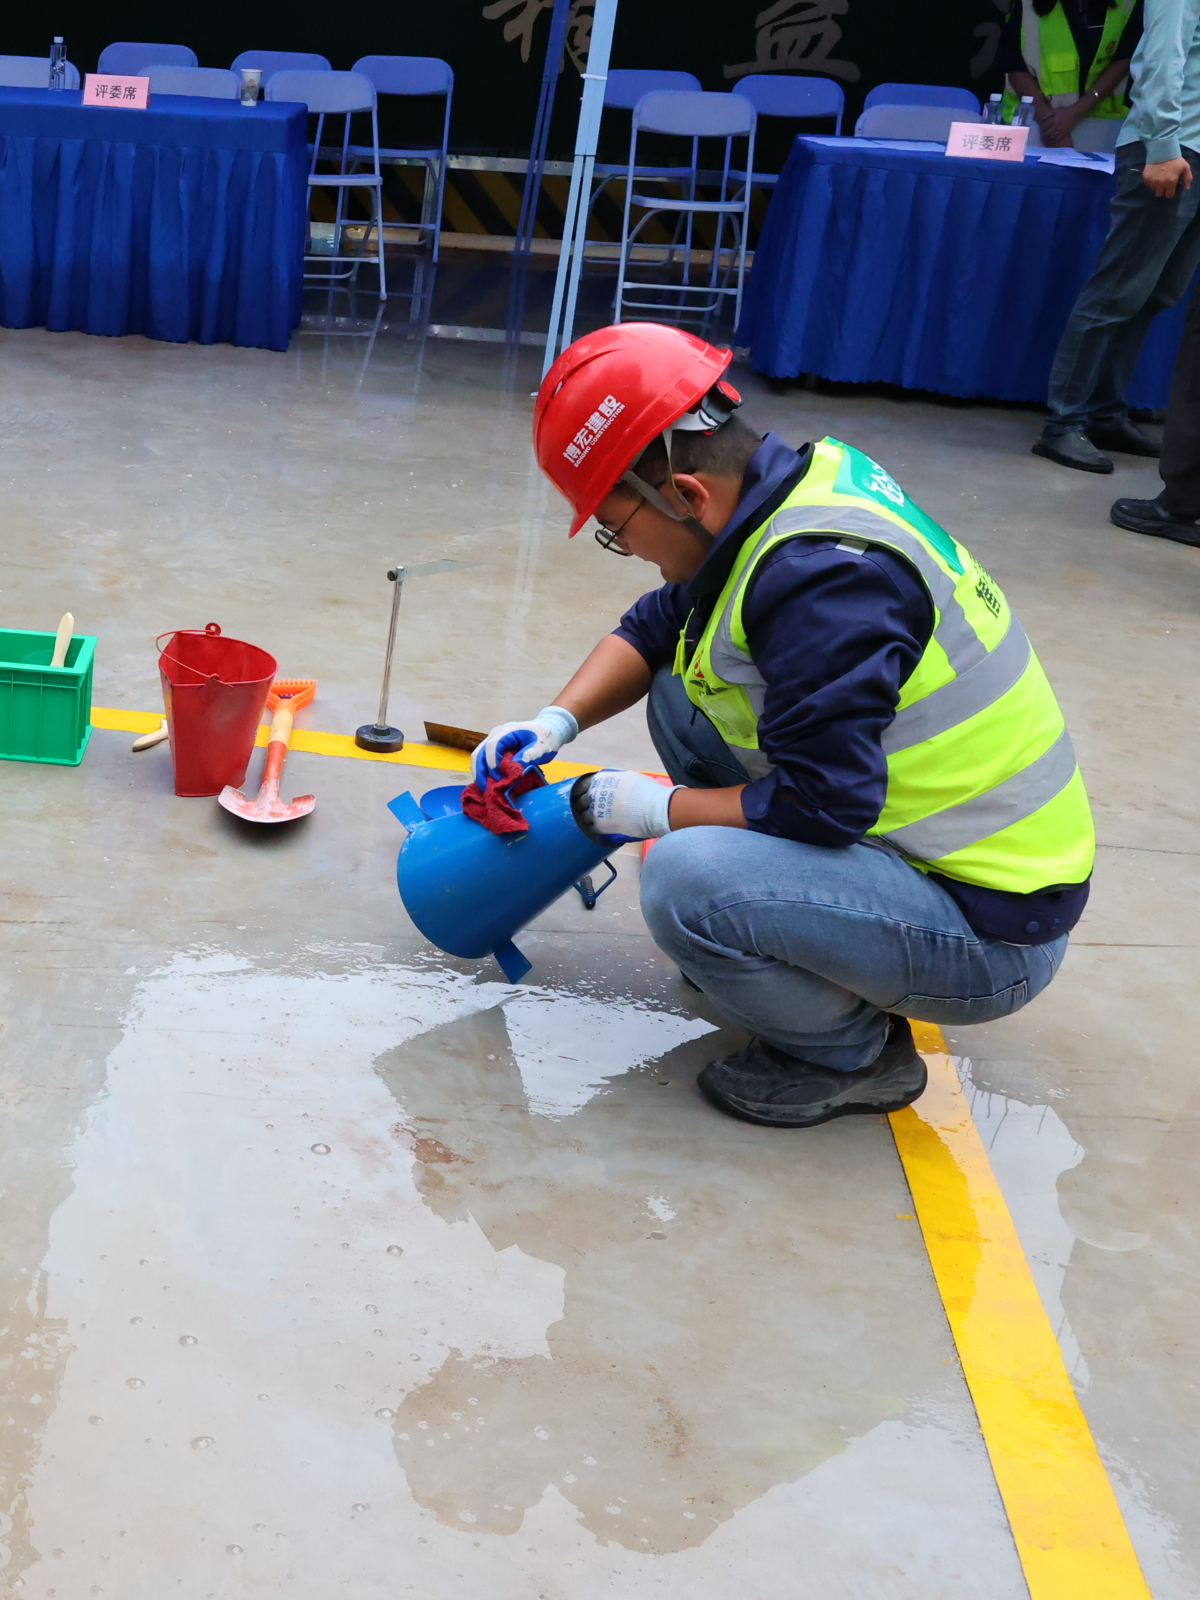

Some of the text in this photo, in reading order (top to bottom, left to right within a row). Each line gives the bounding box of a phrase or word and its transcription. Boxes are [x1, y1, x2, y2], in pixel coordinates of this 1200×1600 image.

[95, 84, 137, 100] 评委席
[962, 134, 1013, 152] 评委席
[590, 403, 626, 445] CONSTRUCTION
